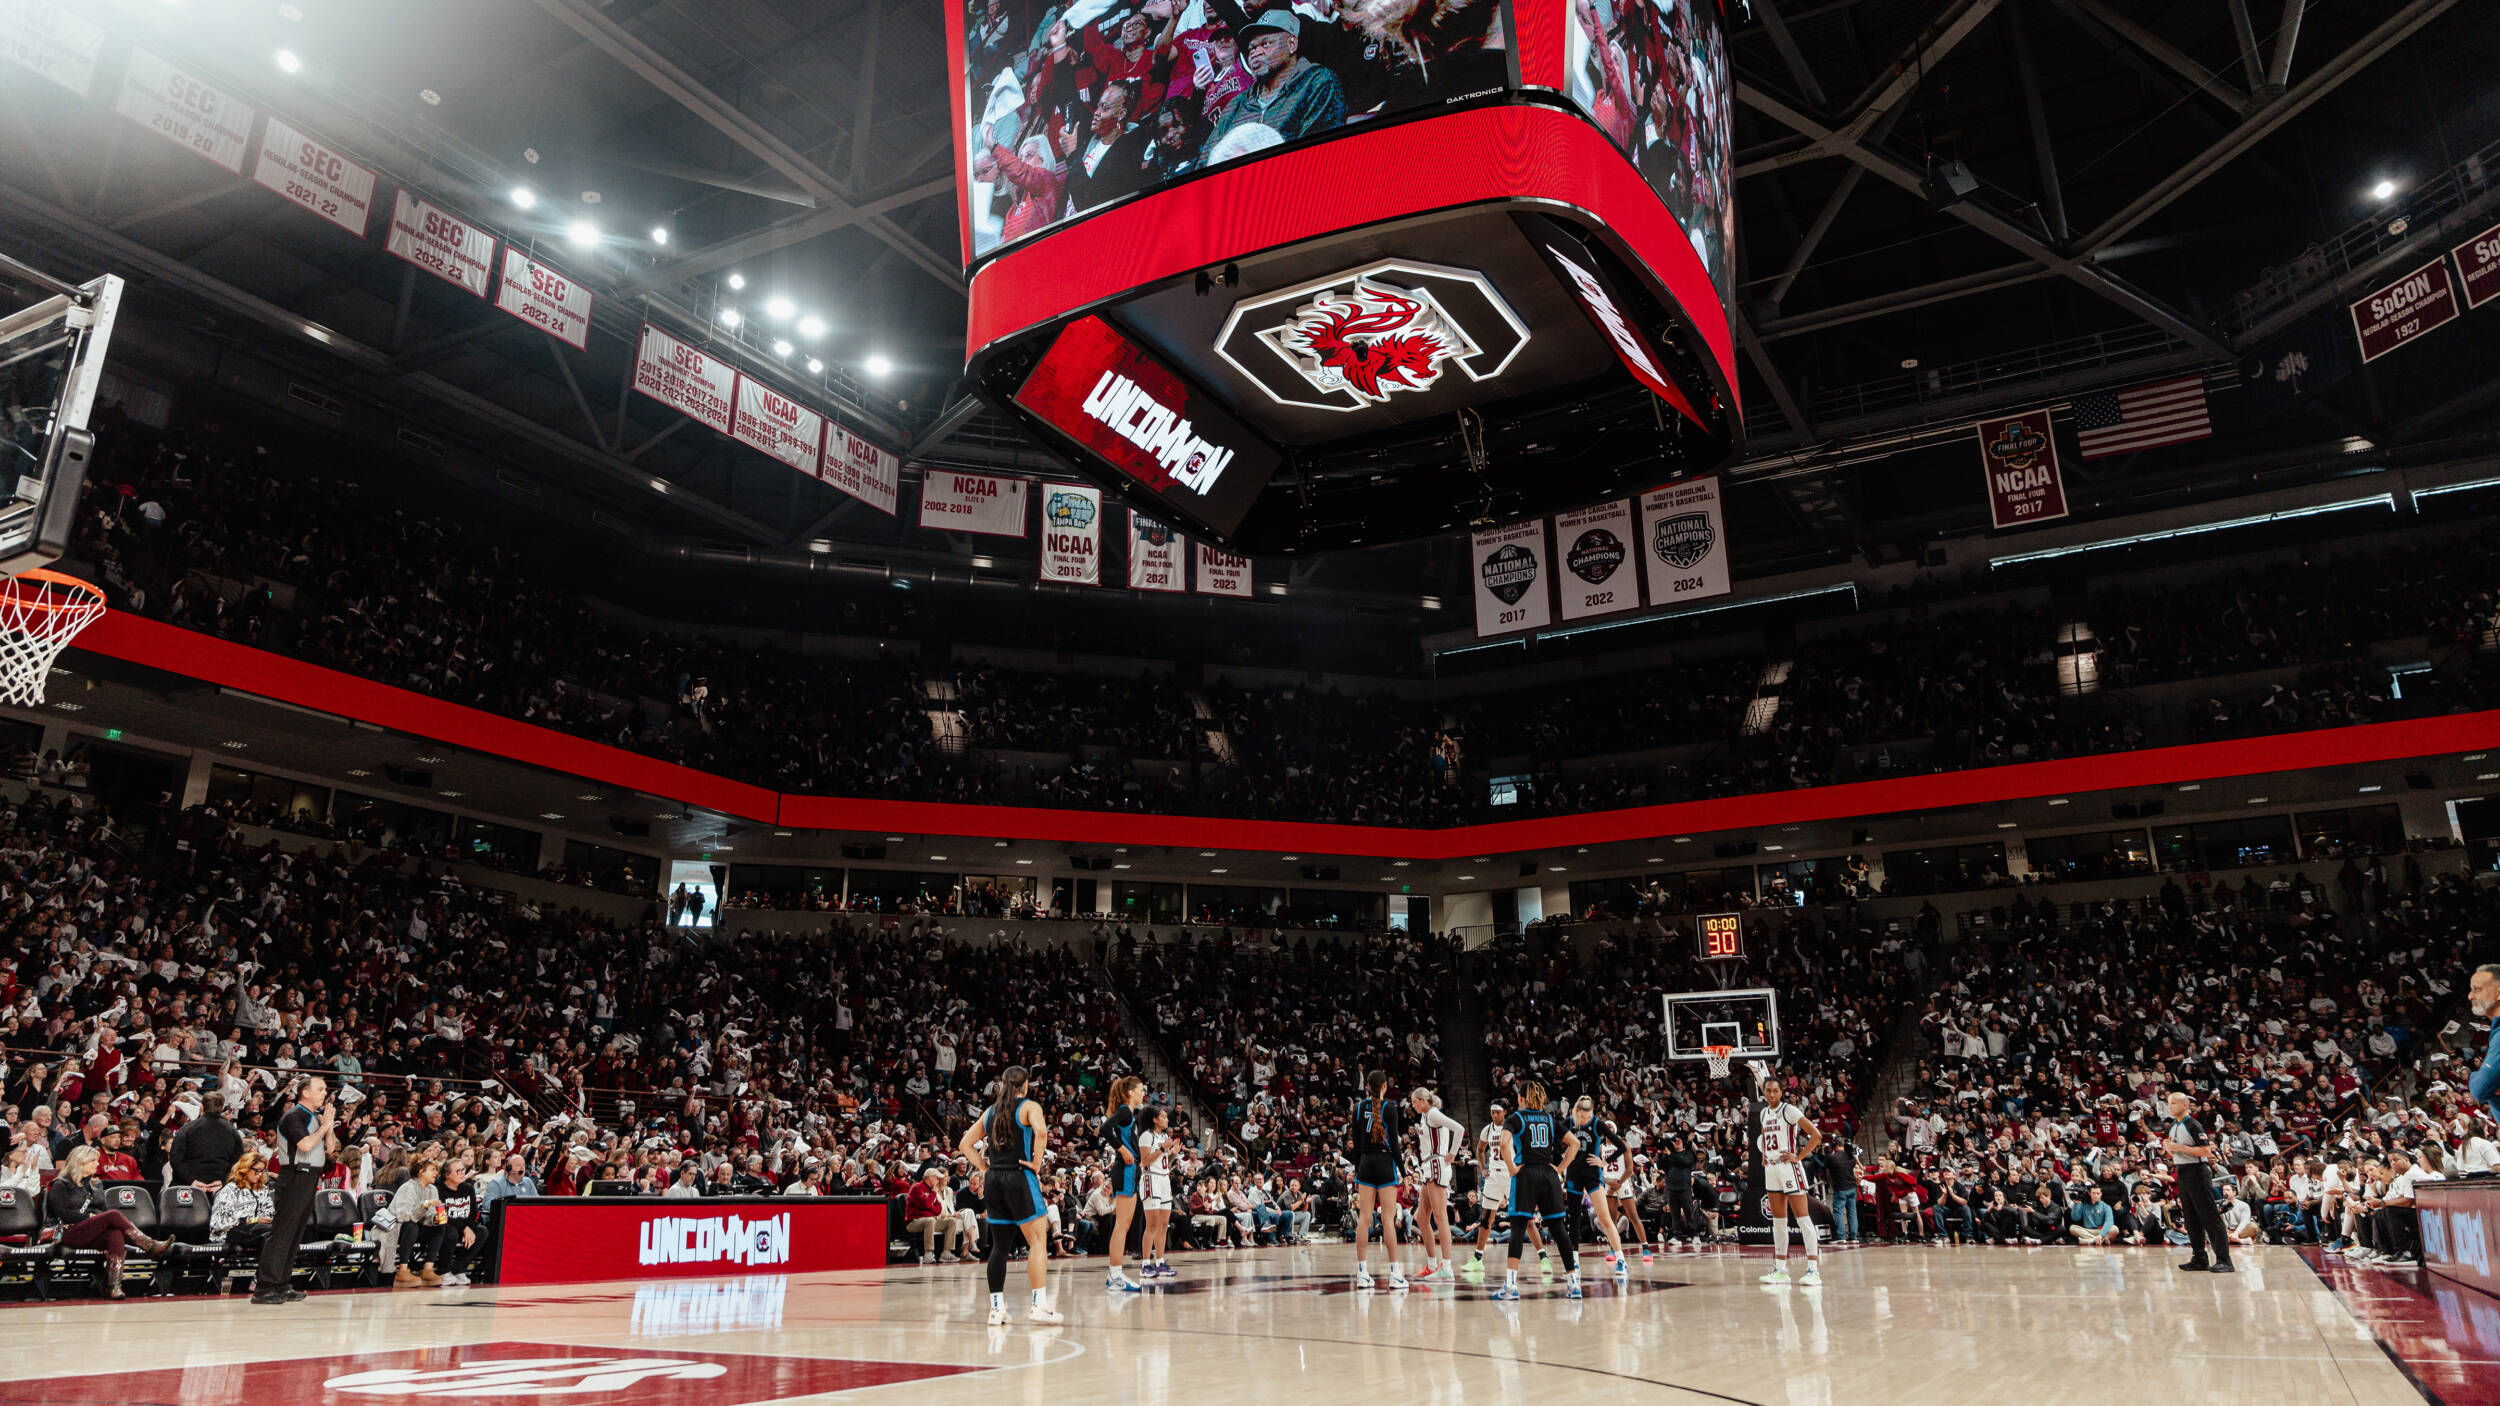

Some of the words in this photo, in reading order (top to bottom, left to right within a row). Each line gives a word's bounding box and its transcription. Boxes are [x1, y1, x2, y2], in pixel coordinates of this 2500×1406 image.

[168, 74, 217, 114] SEC
[1446, 87, 1504, 104] DAKTRONICS
[152, 112, 213, 152] 2019-20
[300, 143, 342, 182] SEC
[264, 150, 329, 190] REGULAR-SEASON
[329, 185, 365, 210] CHAMPION
[286, 181, 338, 217] 2021-22
[426, 212, 463, 248] SEC
[396, 220, 452, 256] REGULAR-SEASON
[453, 250, 487, 273] CHAMPION
[2474, 233, 2500, 264] So
[415, 248, 463, 280] 2022-23
[532, 269, 566, 302] SEC
[2371, 272, 2431, 320] SoCON
[505, 277, 556, 309] REGULAR-SEASON
[557, 304, 586, 325] CHAMPION
[2415, 287, 2447, 310] CHAMPION
[522, 303, 565, 333] 2023-24
[2394, 318, 2420, 340] 1927
[675, 345, 703, 375] SEC
[658, 355, 690, 376] TOURNAMENT
[690, 373, 716, 391] CHAMPION
[640, 360, 662, 378] 2015
[664, 371, 685, 390] 2016
[686, 383, 707, 401] 2017
[708, 394, 728, 412] 2018
[638, 372, 661, 391] 2020
[662, 385, 684, 402] 2021
[685, 396, 708, 414] 2023
[706, 407, 728, 425] 2024
[763, 392, 798, 425] NCAA
[736, 422, 756, 439] 2003
[757, 432, 776, 449] 2013
[739, 410, 758, 427] 1986
[760, 420, 777, 437] 1988
[799, 440, 816, 456] 1991
[1082, 369, 1235, 496] UNCOMMON
[847, 436, 879, 467] NCAA
[1998, 442, 2018, 451] FINAL
[2018, 438, 2037, 449] FOUR
[825, 466, 842, 482] 2016
[843, 477, 860, 492] 2019
[826, 454, 843, 470] 1982
[845, 464, 861, 480] 1990
[862, 474, 879, 488] 2012
[879, 482, 895, 497] 2014
[1995, 465, 2052, 494] NCAA
[953, 476, 998, 498] NCAA
[1653, 491, 1674, 502] SOUTH
[1675, 485, 1706, 498] CAROLINA
[2007, 493, 2027, 503] FINAL
[2028, 488, 2046, 498] FOUR
[924, 501, 947, 512] 2002
[949, 503, 973, 515] 2018
[965, 495, 979, 503] ELITE
[1646, 501, 1674, 512] WOMEN'S
[1675, 493, 1715, 507] BASKETBALL
[2014, 500, 2043, 517] 2017
[1560, 518, 1588, 528] WOMEN'S
[1588, 509, 1626, 523] BASKETBALL
[1566, 509, 1587, 519] SOUTH
[1588, 502, 1618, 515] CAROLINA
[1053, 517, 1072, 528] TAMPA
[1073, 519, 1086, 529] BAY
[1135, 517, 1157, 528] FINAL
[1660, 519, 1706, 538] NATIONAL
[1047, 533, 1093, 556] NCAA
[1476, 535, 1503, 547] WOMEN'S
[1503, 528, 1539, 541] BASKETBALL
[1657, 530, 1712, 551] CHAMPIONS
[1053, 554, 1070, 562] FINAL
[1071, 556, 1087, 565] FOUR
[1147, 549, 1168, 559] NCAA
[1573, 551, 1621, 567] CHAMPIONS
[1581, 545, 1609, 555] NATIONAL
[1057, 566, 1082, 577] 2015
[1142, 560, 1157, 568] FINAL
[1158, 561, 1173, 569] FOUR
[1209, 568, 1224, 576] FINAL
[1226, 569, 1240, 577] FOUR
[1484, 557, 1534, 576] NATIONAL
[1146, 573, 1169, 585] 2021
[1213, 579, 1237, 590] 2023
[1487, 569, 1534, 587] CHAMPIONS
[1673, 576, 1704, 593] 2024
[1585, 591, 1614, 607] 2022
[1500, 609, 1525, 624] 2017
[1707, 918, 1737, 931] 10:00
[1707, 931, 1736, 954] 30
[1364, 1111, 1373, 1133] 7
[2102, 1124, 2111, 1133] 12
[1529, 1123, 1549, 1148] 10
[1766, 1134, 1778, 1151] 23
[1162, 1155, 1168, 1170] 0
[1606, 1160, 1619, 1172] 25
[639, 1212, 790, 1266] UNCOMMON
